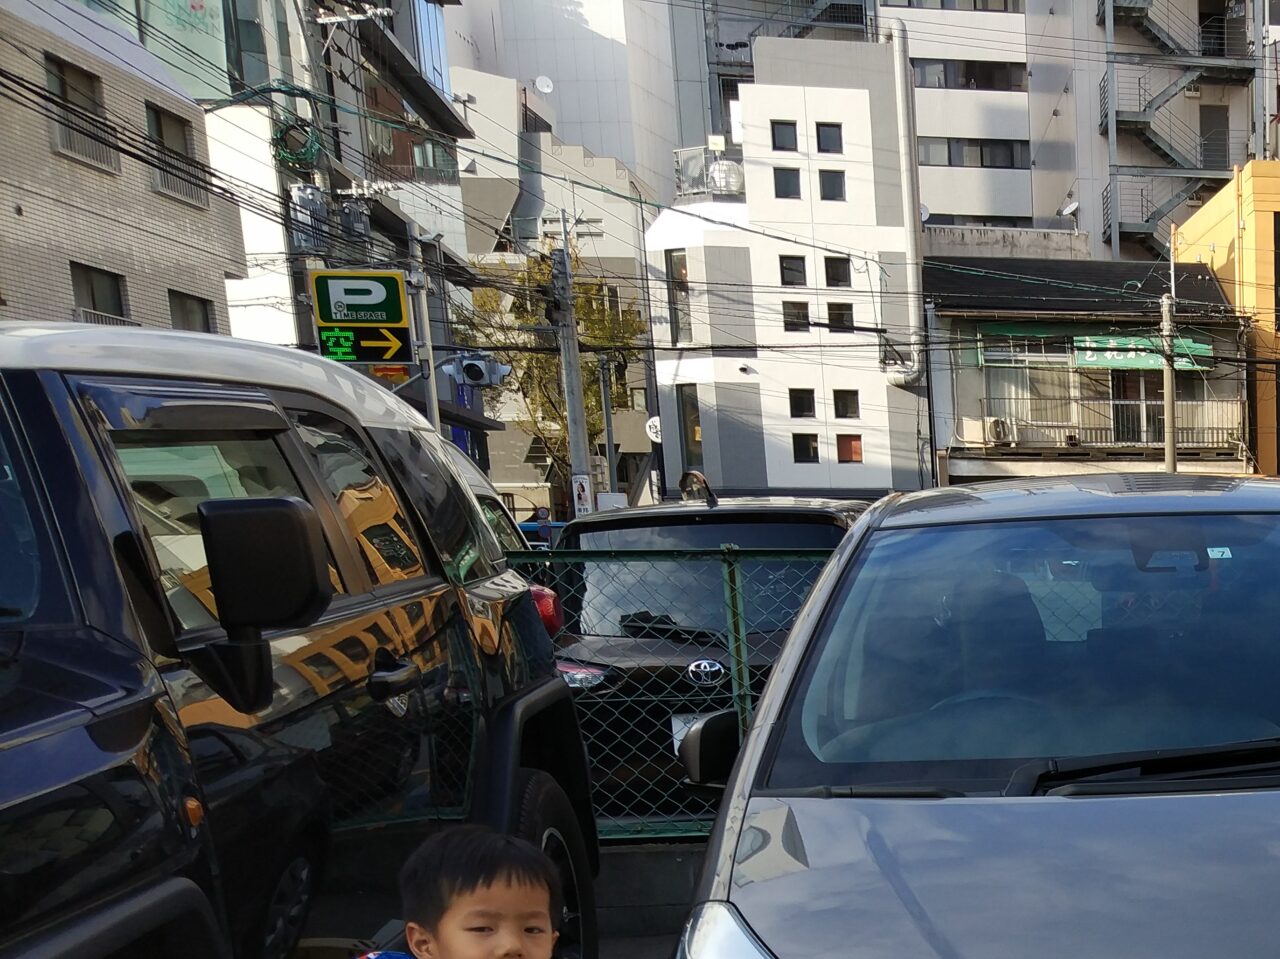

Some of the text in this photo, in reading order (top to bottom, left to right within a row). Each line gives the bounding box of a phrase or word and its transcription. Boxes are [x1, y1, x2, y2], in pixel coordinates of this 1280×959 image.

[328, 280, 387, 319] P
[333, 311, 387, 320] TIME SPACE
[321, 328, 357, 360] 空
